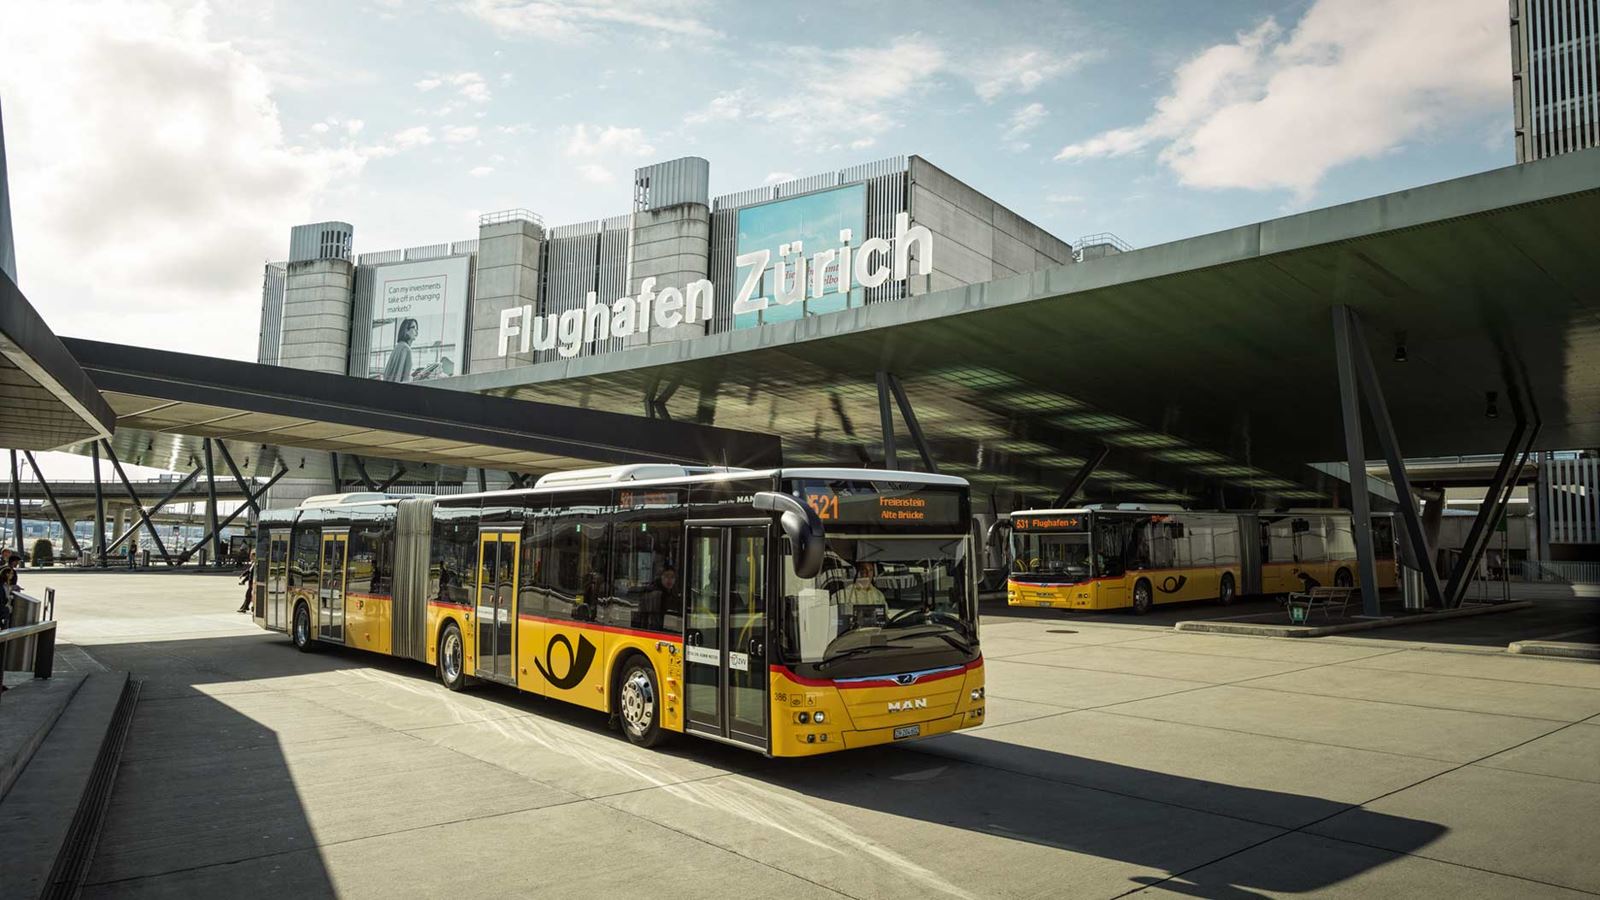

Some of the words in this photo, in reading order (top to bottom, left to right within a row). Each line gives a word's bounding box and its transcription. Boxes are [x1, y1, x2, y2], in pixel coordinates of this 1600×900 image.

[388, 286, 400, 294] Can
[400, 286, 409, 294] my
[409, 283, 441, 292] investments
[498, 276, 714, 357] Flughafen
[733, 212, 933, 315] Zürich
[387, 295, 399, 303] take
[400, 294, 409, 302] off
[415, 293, 441, 302] changing
[387, 305, 412, 313] markets?
[879, 496, 925, 507] Freienstein
[807, 495, 839, 519] 521
[881, 511, 897, 519] Alte
[898, 511, 924, 519] Brücke
[1016, 519, 1029, 528] 531
[1032, 518, 1069, 528] Flughafen
[775, 692, 787, 702] 386
[888, 697, 927, 711] MAN
